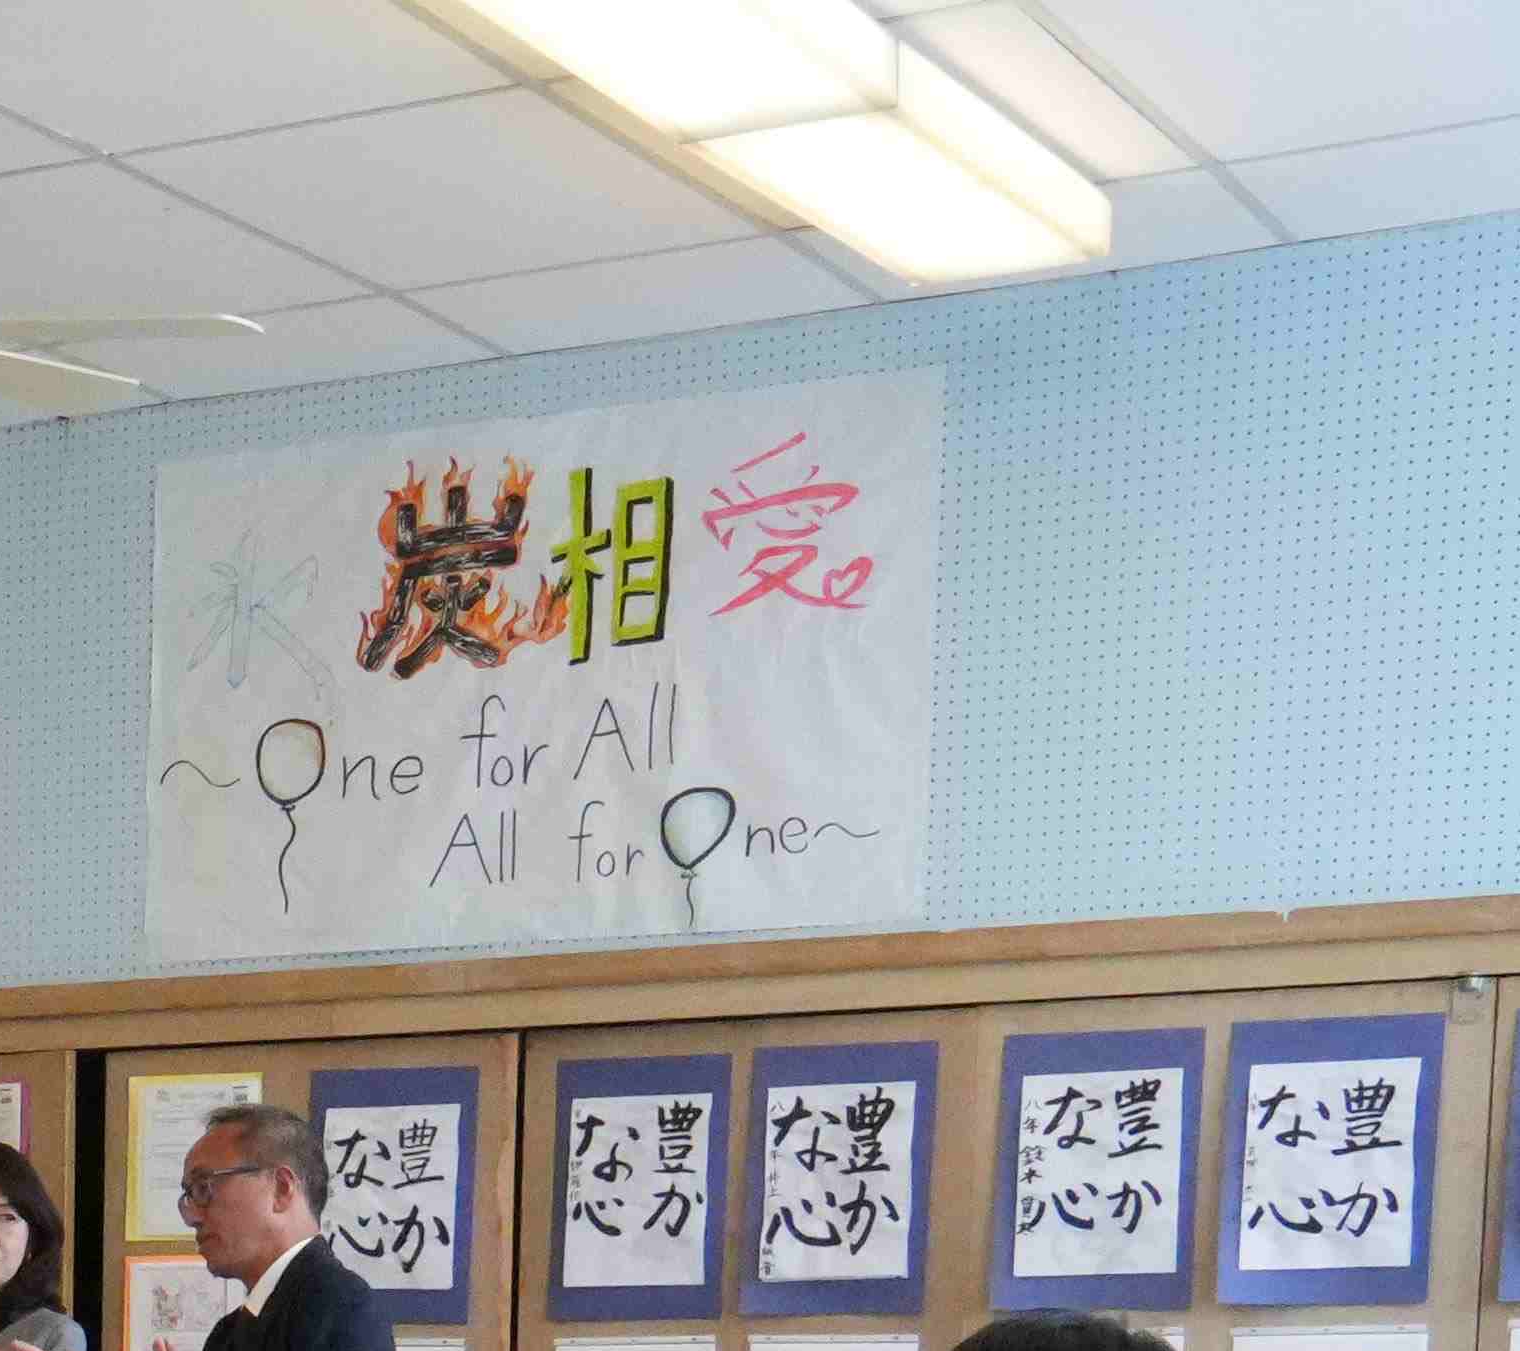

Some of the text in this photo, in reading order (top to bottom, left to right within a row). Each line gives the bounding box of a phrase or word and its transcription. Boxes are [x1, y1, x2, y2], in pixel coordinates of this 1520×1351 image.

[460, 695, 549, 790] for
[574, 682, 677, 780] All
[430, 809, 517, 888] All
[569, 802, 644, 883] for
[392, 1117, 451, 1275] 豊か
[572, 1114, 641, 1238] な心
[642, 1100, 705, 1239] 豊か
[766, 1096, 843, 1248] な心
[839, 1086, 900, 1256] 豊か
[1033, 1085, 1105, 1232] な心
[1106, 1078, 1163, 1235] 豊か
[1247, 1084, 1330, 1235] な心
[1320, 1077, 1403, 1238] 豊か
